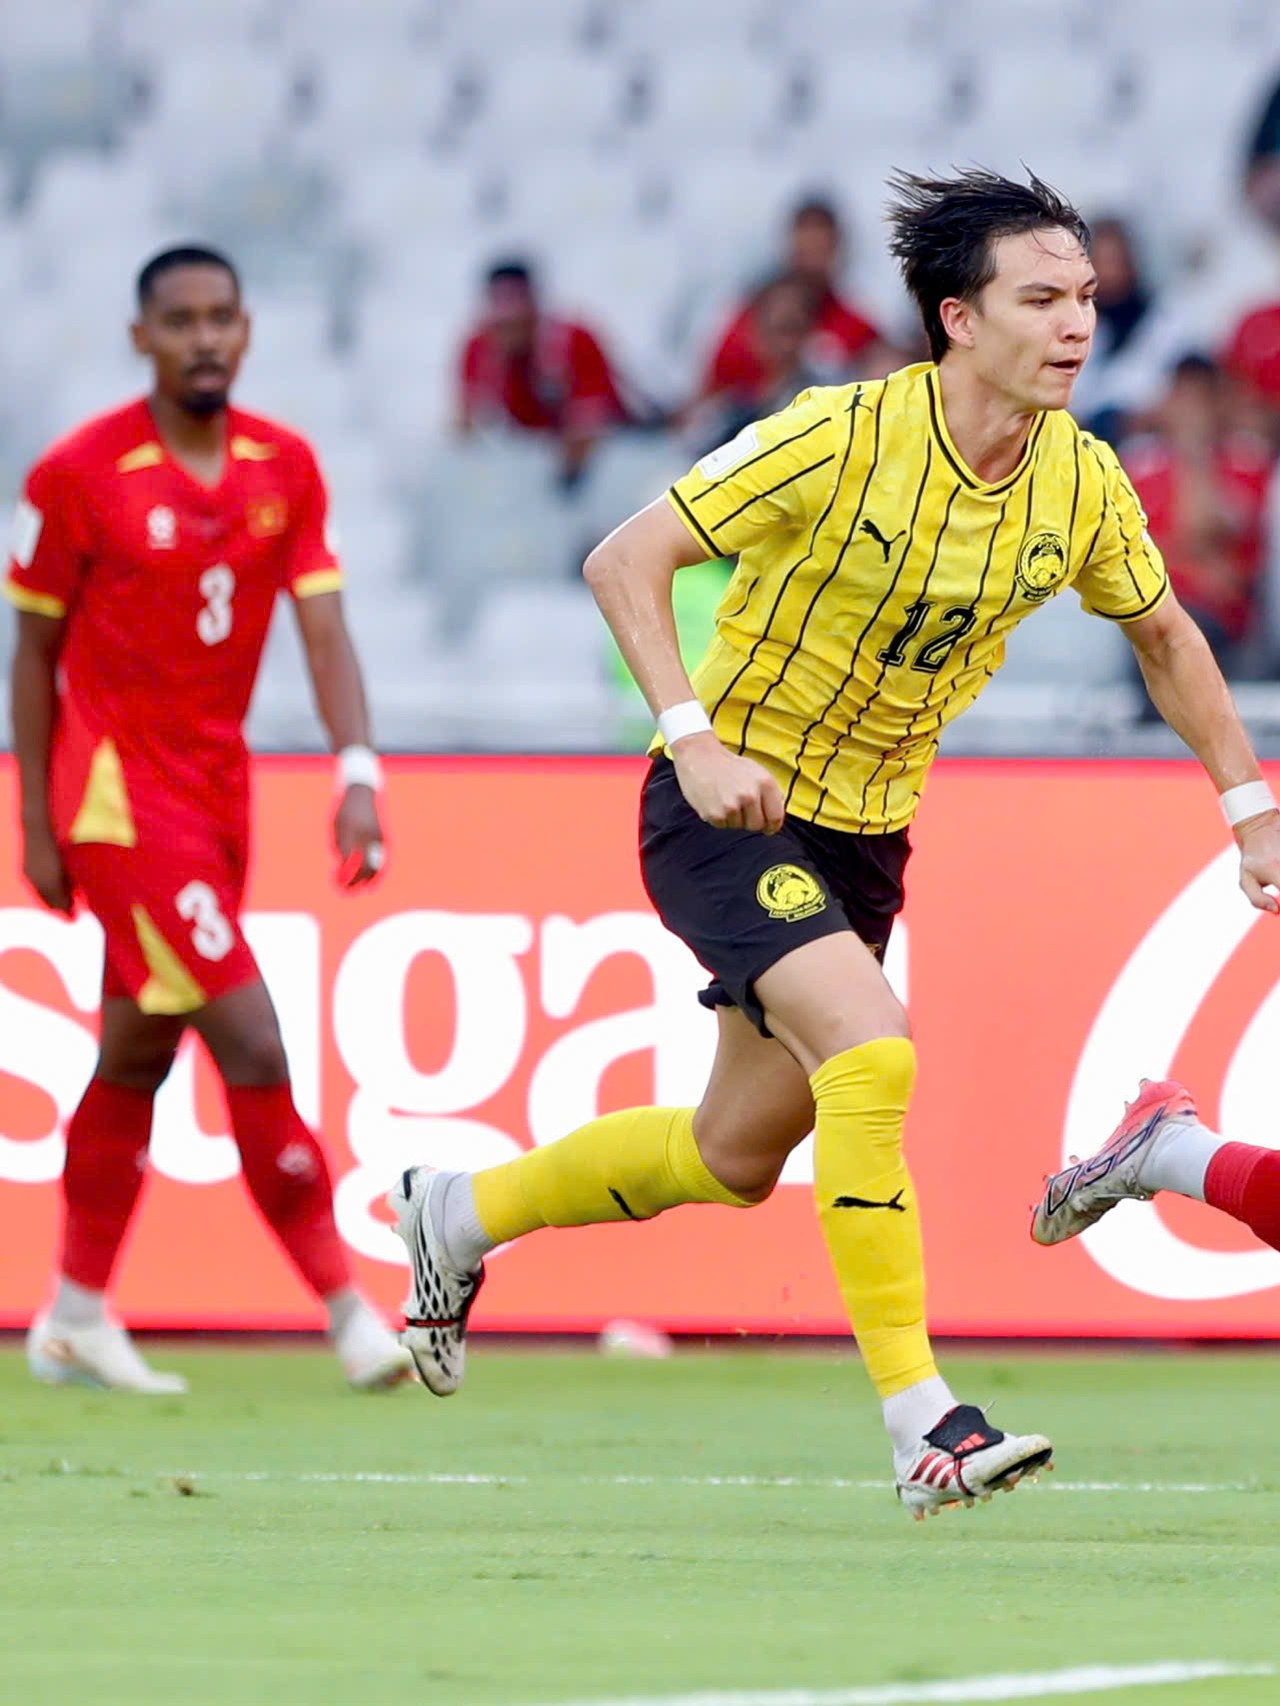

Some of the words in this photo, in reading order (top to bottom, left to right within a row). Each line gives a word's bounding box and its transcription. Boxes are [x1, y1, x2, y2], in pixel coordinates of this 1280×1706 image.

[197, 563, 235, 646] 3
[876, 600, 979, 674] 12
[175, 880, 234, 960] 3
